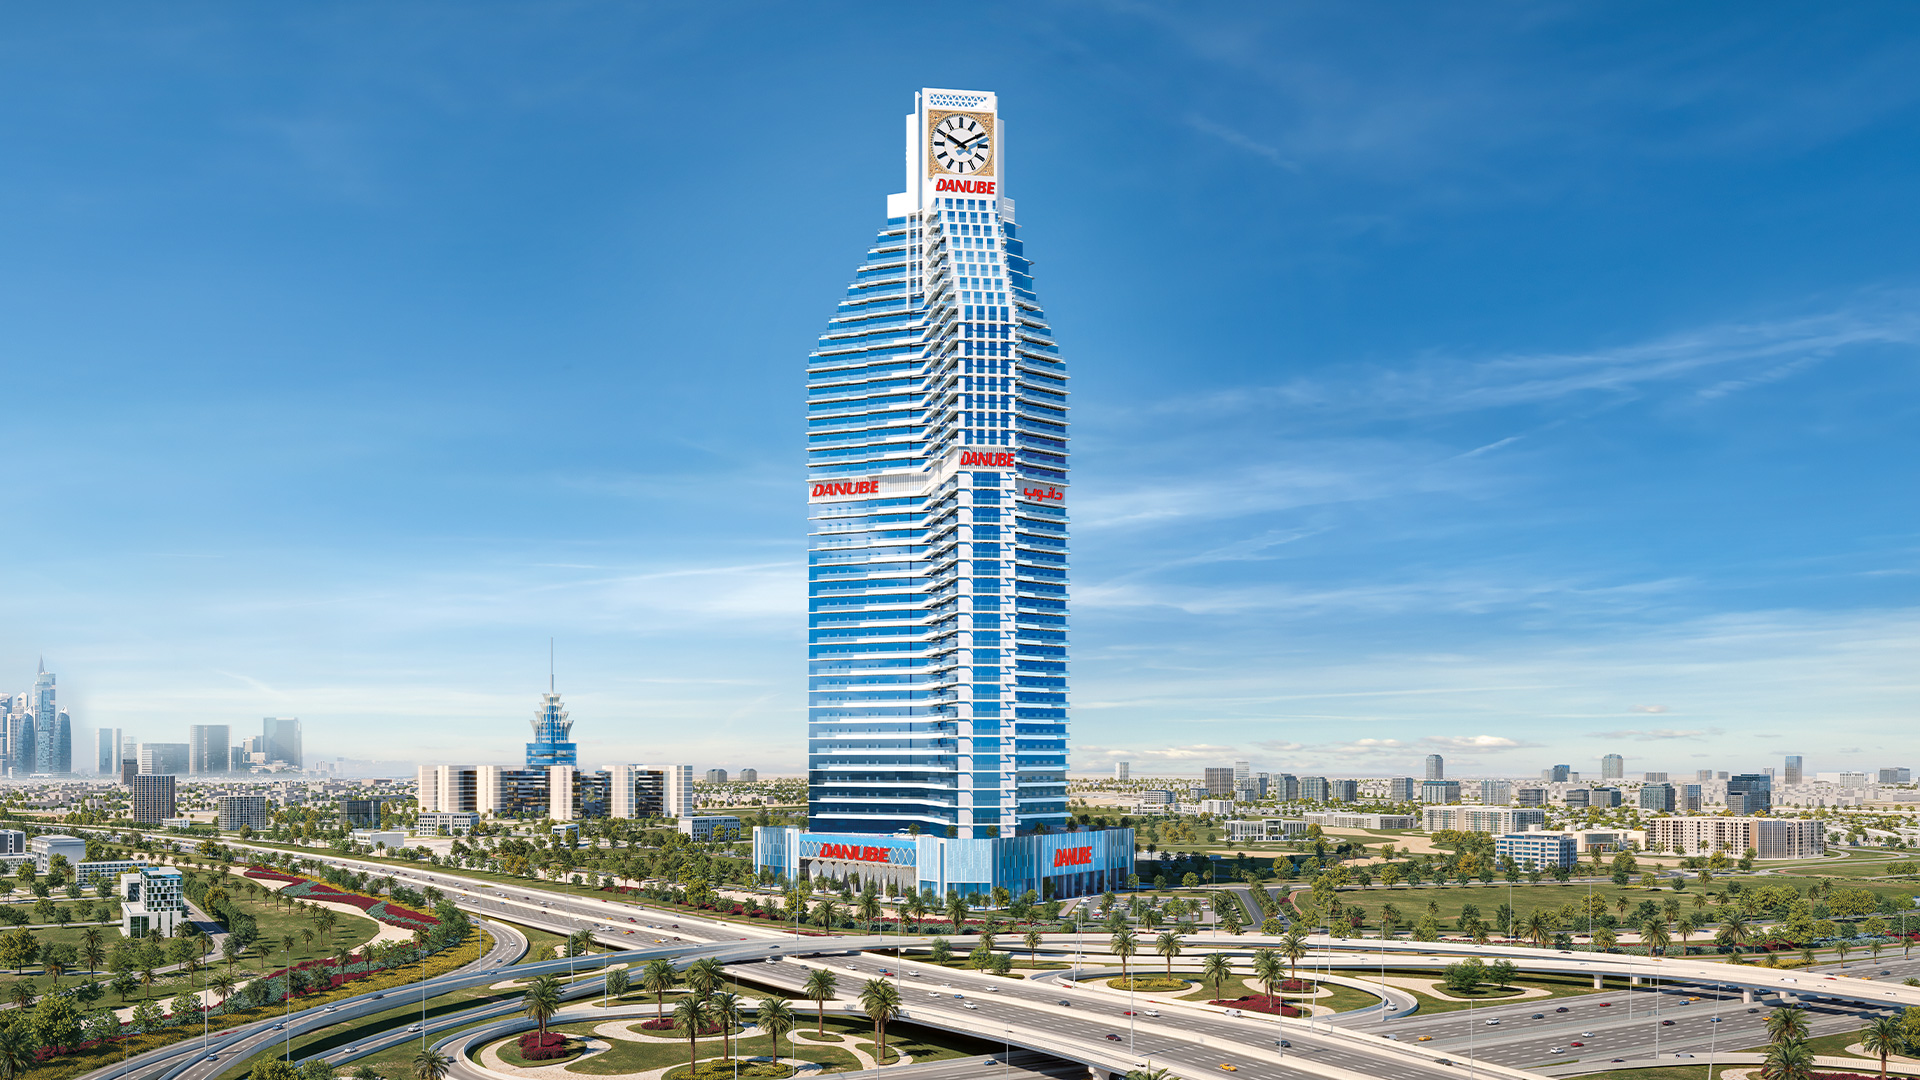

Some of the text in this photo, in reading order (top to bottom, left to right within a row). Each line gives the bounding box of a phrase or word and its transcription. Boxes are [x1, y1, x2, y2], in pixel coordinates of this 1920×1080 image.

[936, 178, 996, 195] DANUBE
[960, 451, 1015, 467] DANUBE
[812, 480, 879, 497] DANUBE
[1024, 487, 1064, 502] دانوب
[820, 843, 890, 863] DANUBE
[1054, 846, 1093, 868] DANUBE
